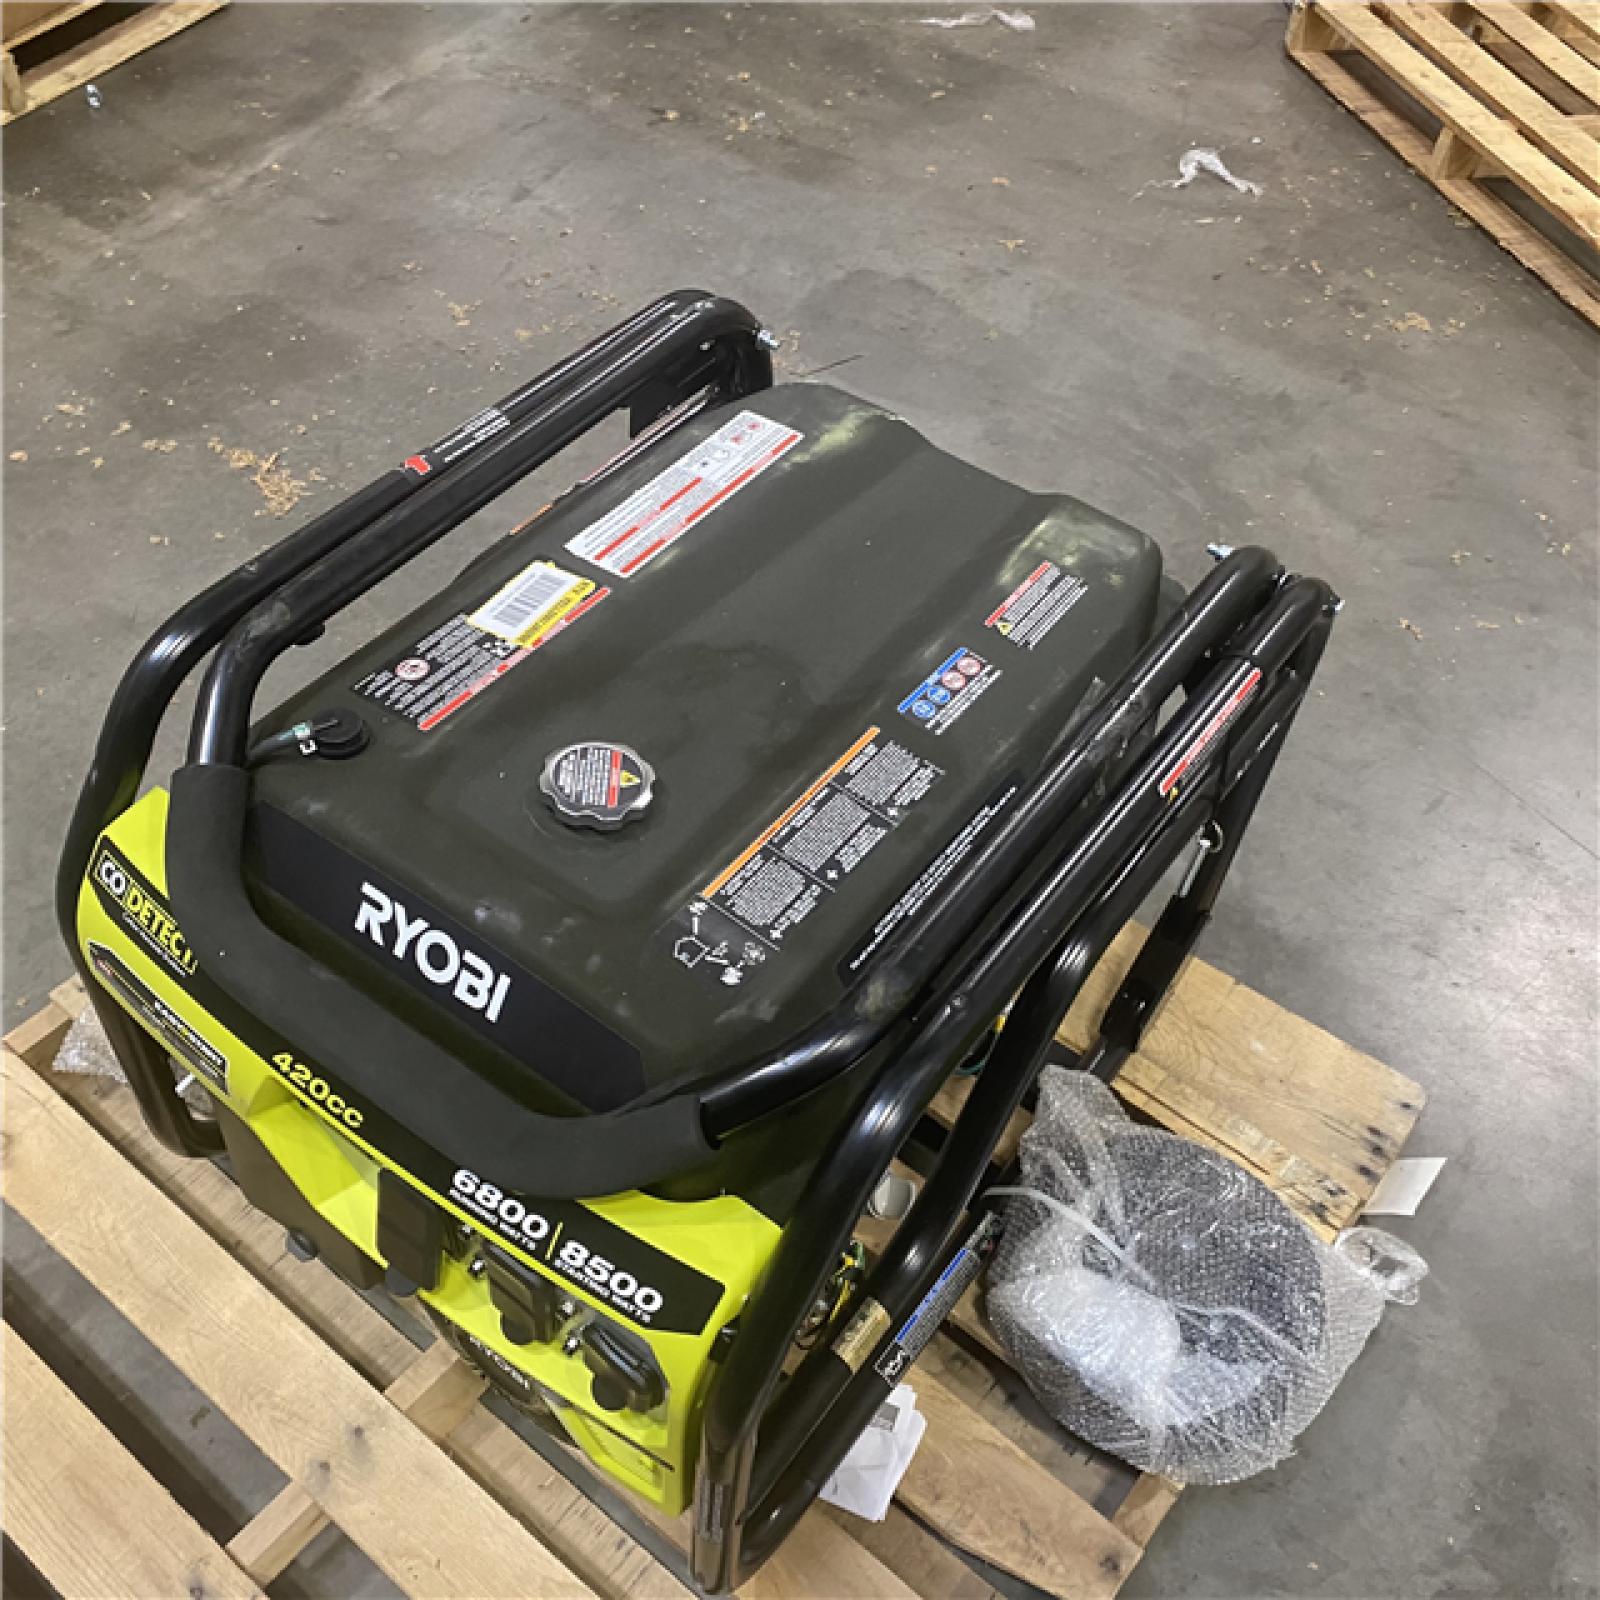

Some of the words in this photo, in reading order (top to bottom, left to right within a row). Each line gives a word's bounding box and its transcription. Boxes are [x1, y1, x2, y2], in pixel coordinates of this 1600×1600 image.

[102, 861, 126, 895] CO
[355, 881, 511, 1023] RYOBI
[453, 1169, 549, 1241] 6800
[559, 1240, 664, 1314] 8500
